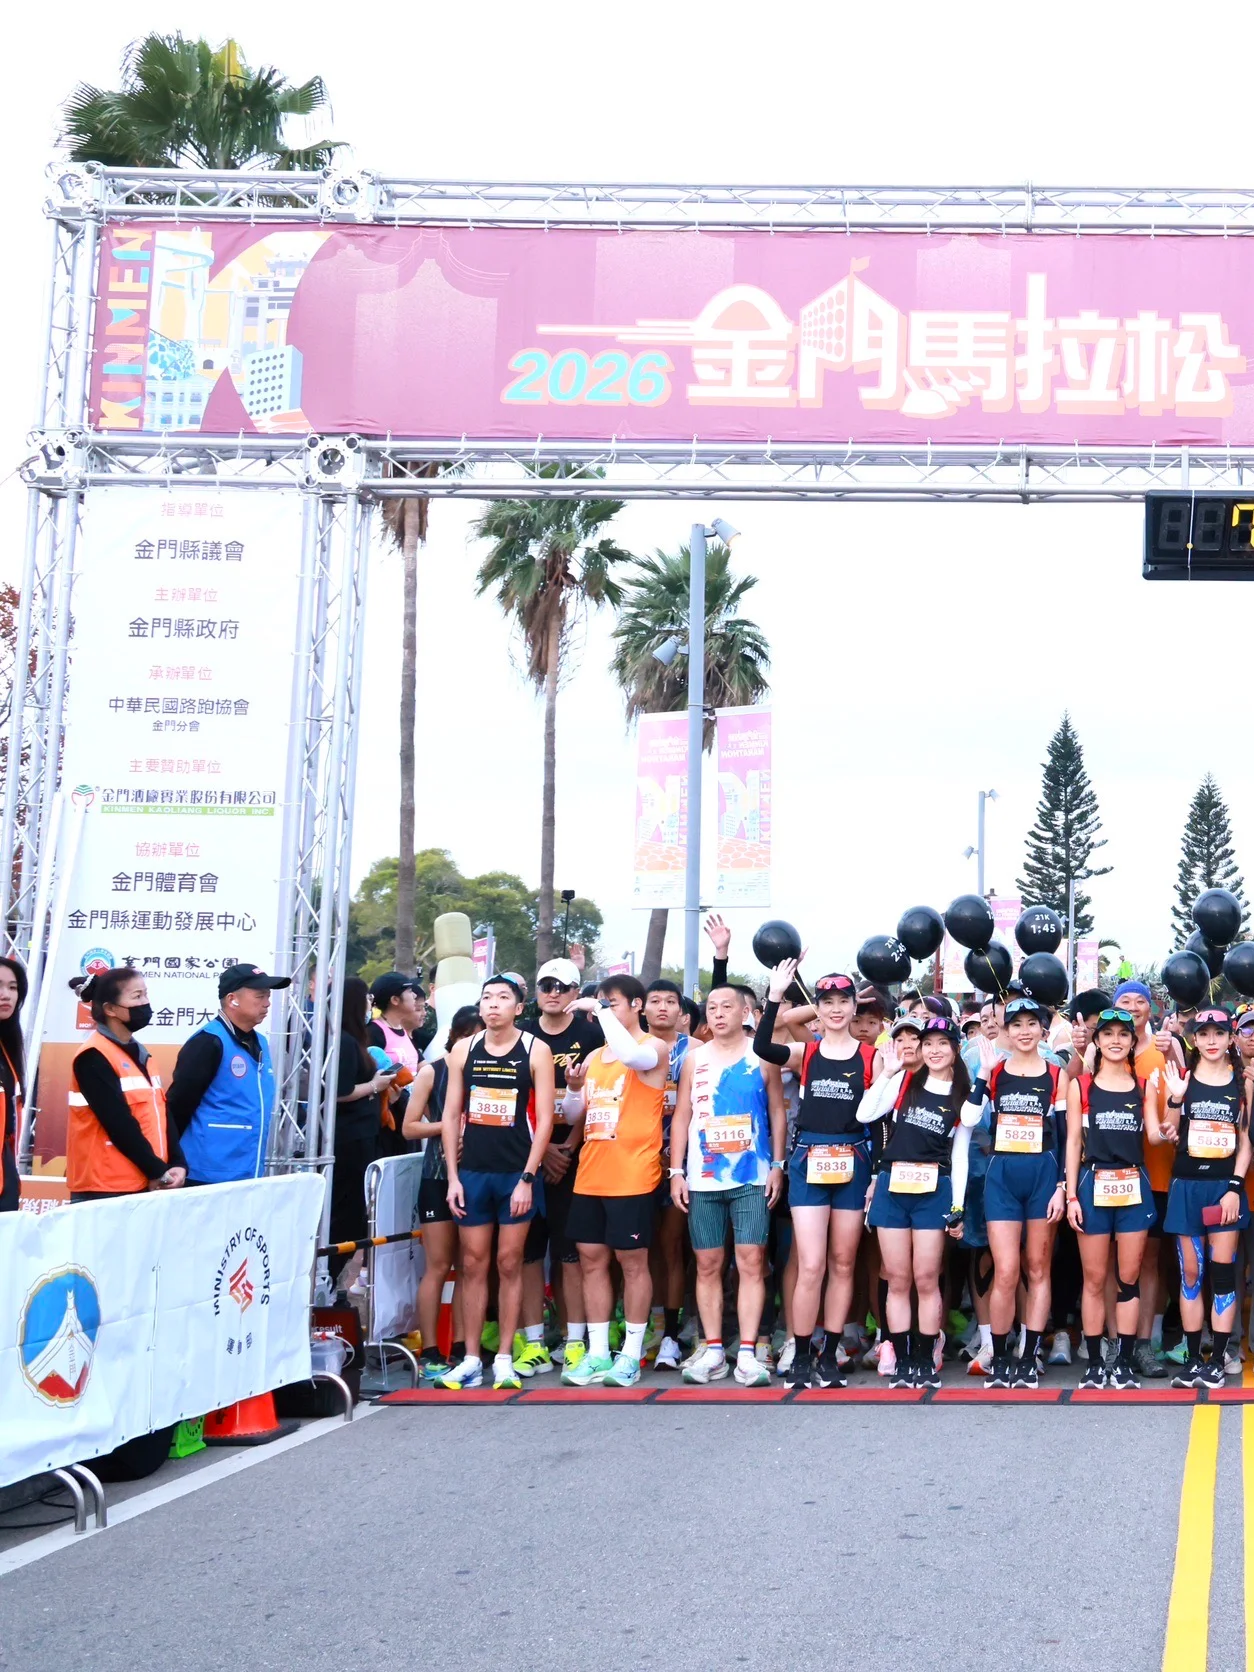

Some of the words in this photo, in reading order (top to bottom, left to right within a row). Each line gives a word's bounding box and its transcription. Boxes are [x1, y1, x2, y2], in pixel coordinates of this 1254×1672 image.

[99, 228, 153, 429] KINMEN
[686, 265, 1243, 417] 金門馬拉松
[502, 349, 673, 405] 2026
[161, 502, 224, 518] 指導單位
[134, 539, 245, 562] 金門縣議會
[154, 588, 218, 602] 主辦單位
[128, 617, 240, 640] 金門縣政府
[149, 665, 213, 681] 承辦單位
[108, 697, 250, 716] 中華民國路跑協會
[152, 719, 200, 732] 金門分會
[129, 759, 222, 774] 主要贊助單位
[103, 805, 144, 814] KINMEN
[148, 806, 203, 815] KAOLIANG
[207, 807, 246, 815] LIQUOR
[251, 808, 272, 816] INC.
[135, 841, 200, 858] 協辦單位
[111, 871, 219, 893] 金門體育會
[67, 909, 256, 932] 金門縣運動發展中心
[1031, 924, 1056, 934] 1:45
[164, 971, 211, 979] NATIONAL
[477, 1102, 507, 1114] 3838
[588, 1112, 611, 1122] 3835
[714, 1129, 745, 1141] 3116
[1005, 1129, 1035, 1140] 5829
[1197, 1136, 1228, 1147] 5833
[816, 1161, 847, 1171] 5838
[899, 1171, 930, 1181] 5925
[1103, 1184, 1133, 1194] 5830
[213, 1231, 242, 1317] MINISTRY
[244, 1227, 257, 1242] OF
[256, 1235, 271, 1306] SPORTS
